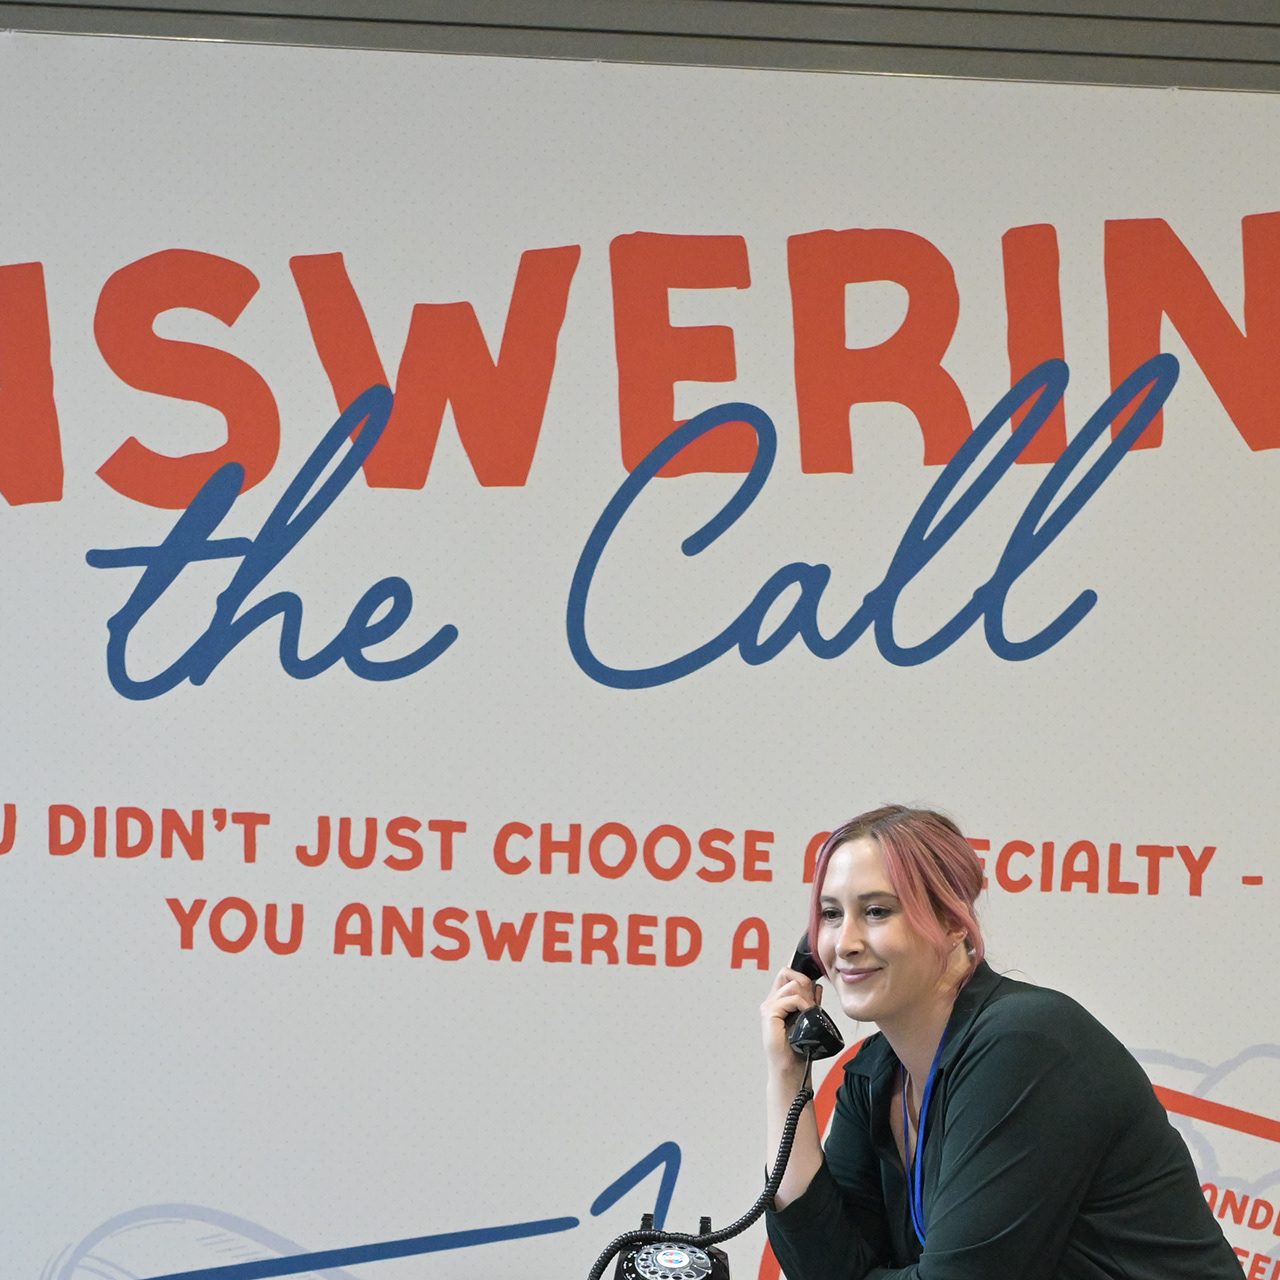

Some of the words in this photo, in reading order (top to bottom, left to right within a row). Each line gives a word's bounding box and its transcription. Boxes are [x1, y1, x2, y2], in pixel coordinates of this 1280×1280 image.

[87, 386, 457, 700] the
[567, 354, 1179, 688] Call
[296, 816, 467, 871] JUST
[493, 822, 775, 883] CHOOSE
[966, 836, 1216, 897] CIALTY
[166, 896, 304, 955] YOU
[334, 902, 702, 967] ANSWERED
[731, 917, 770, 971] A
